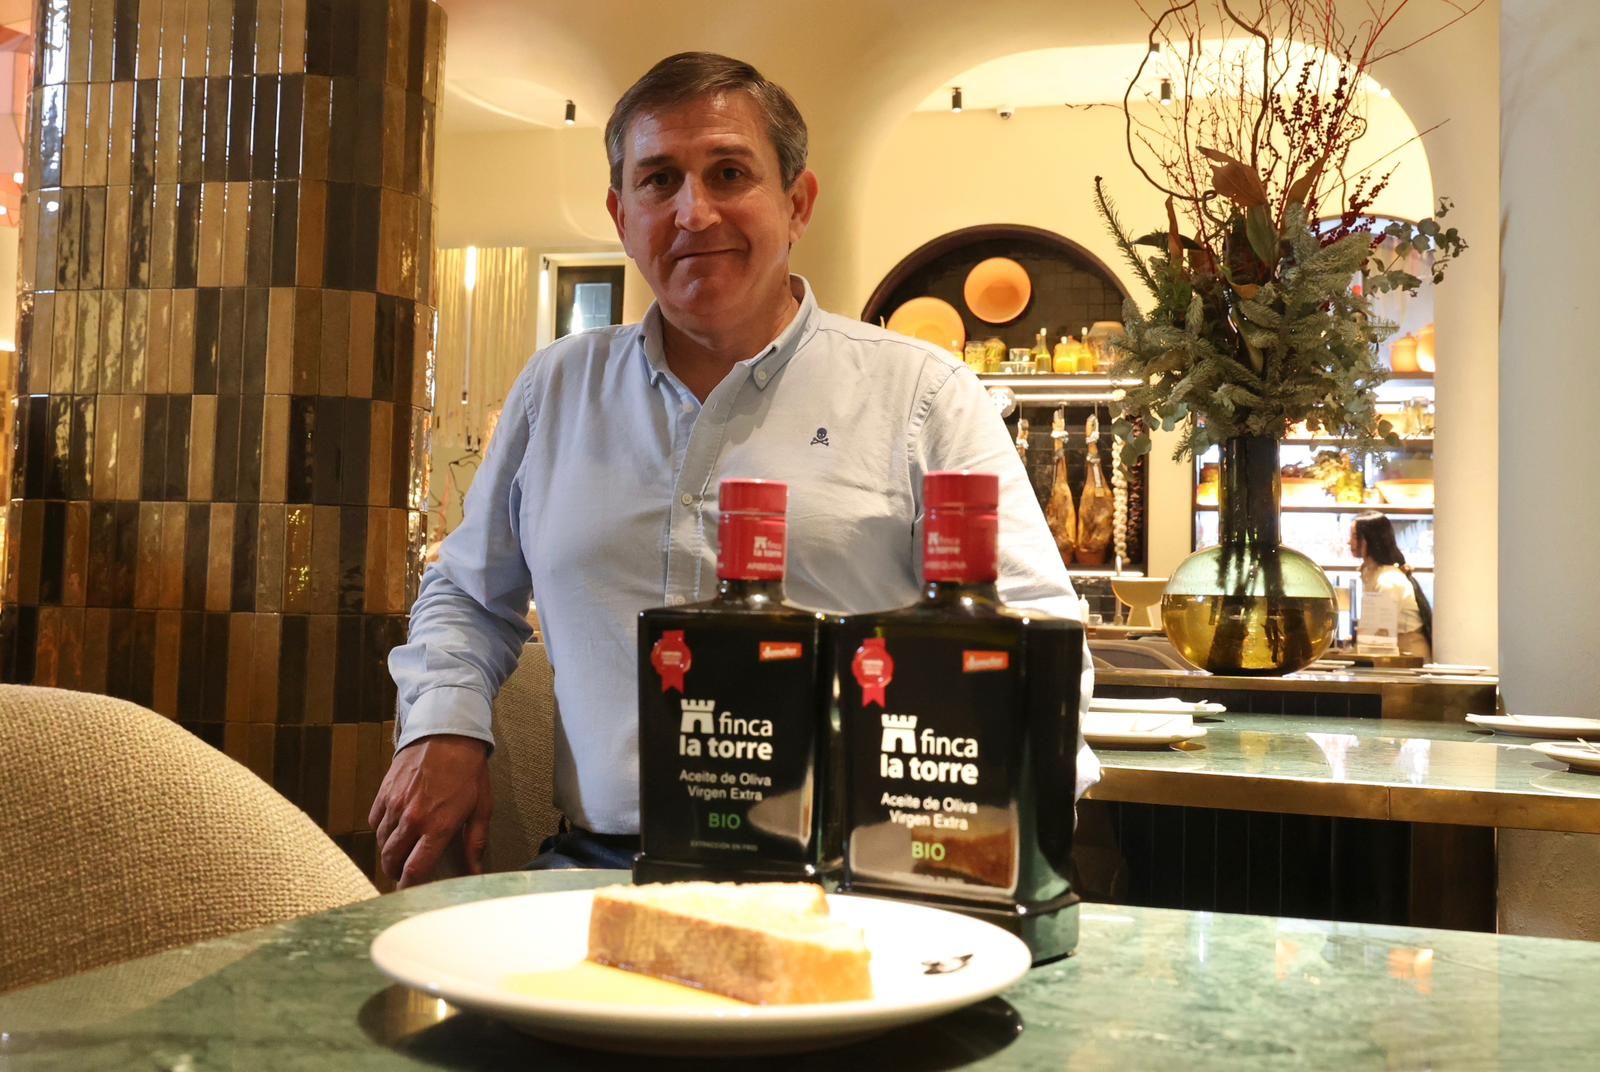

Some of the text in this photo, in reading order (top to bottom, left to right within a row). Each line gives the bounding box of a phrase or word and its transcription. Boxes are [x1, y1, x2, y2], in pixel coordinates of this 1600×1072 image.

[719, 711, 773, 737] finca
[679, 734, 774, 761] la torre
[920, 728, 979, 759] finca
[679, 769, 772, 787] Aceite de Oliva
[880, 754, 979, 785] la torre
[688, 785, 763, 801] Virgen Extra
[881, 791, 978, 814] Aceite de Oliva
[708, 812, 741, 830] BIO
[889, 809, 969, 831] Virgen Extra
[911, 841, 946, 861] BIO
